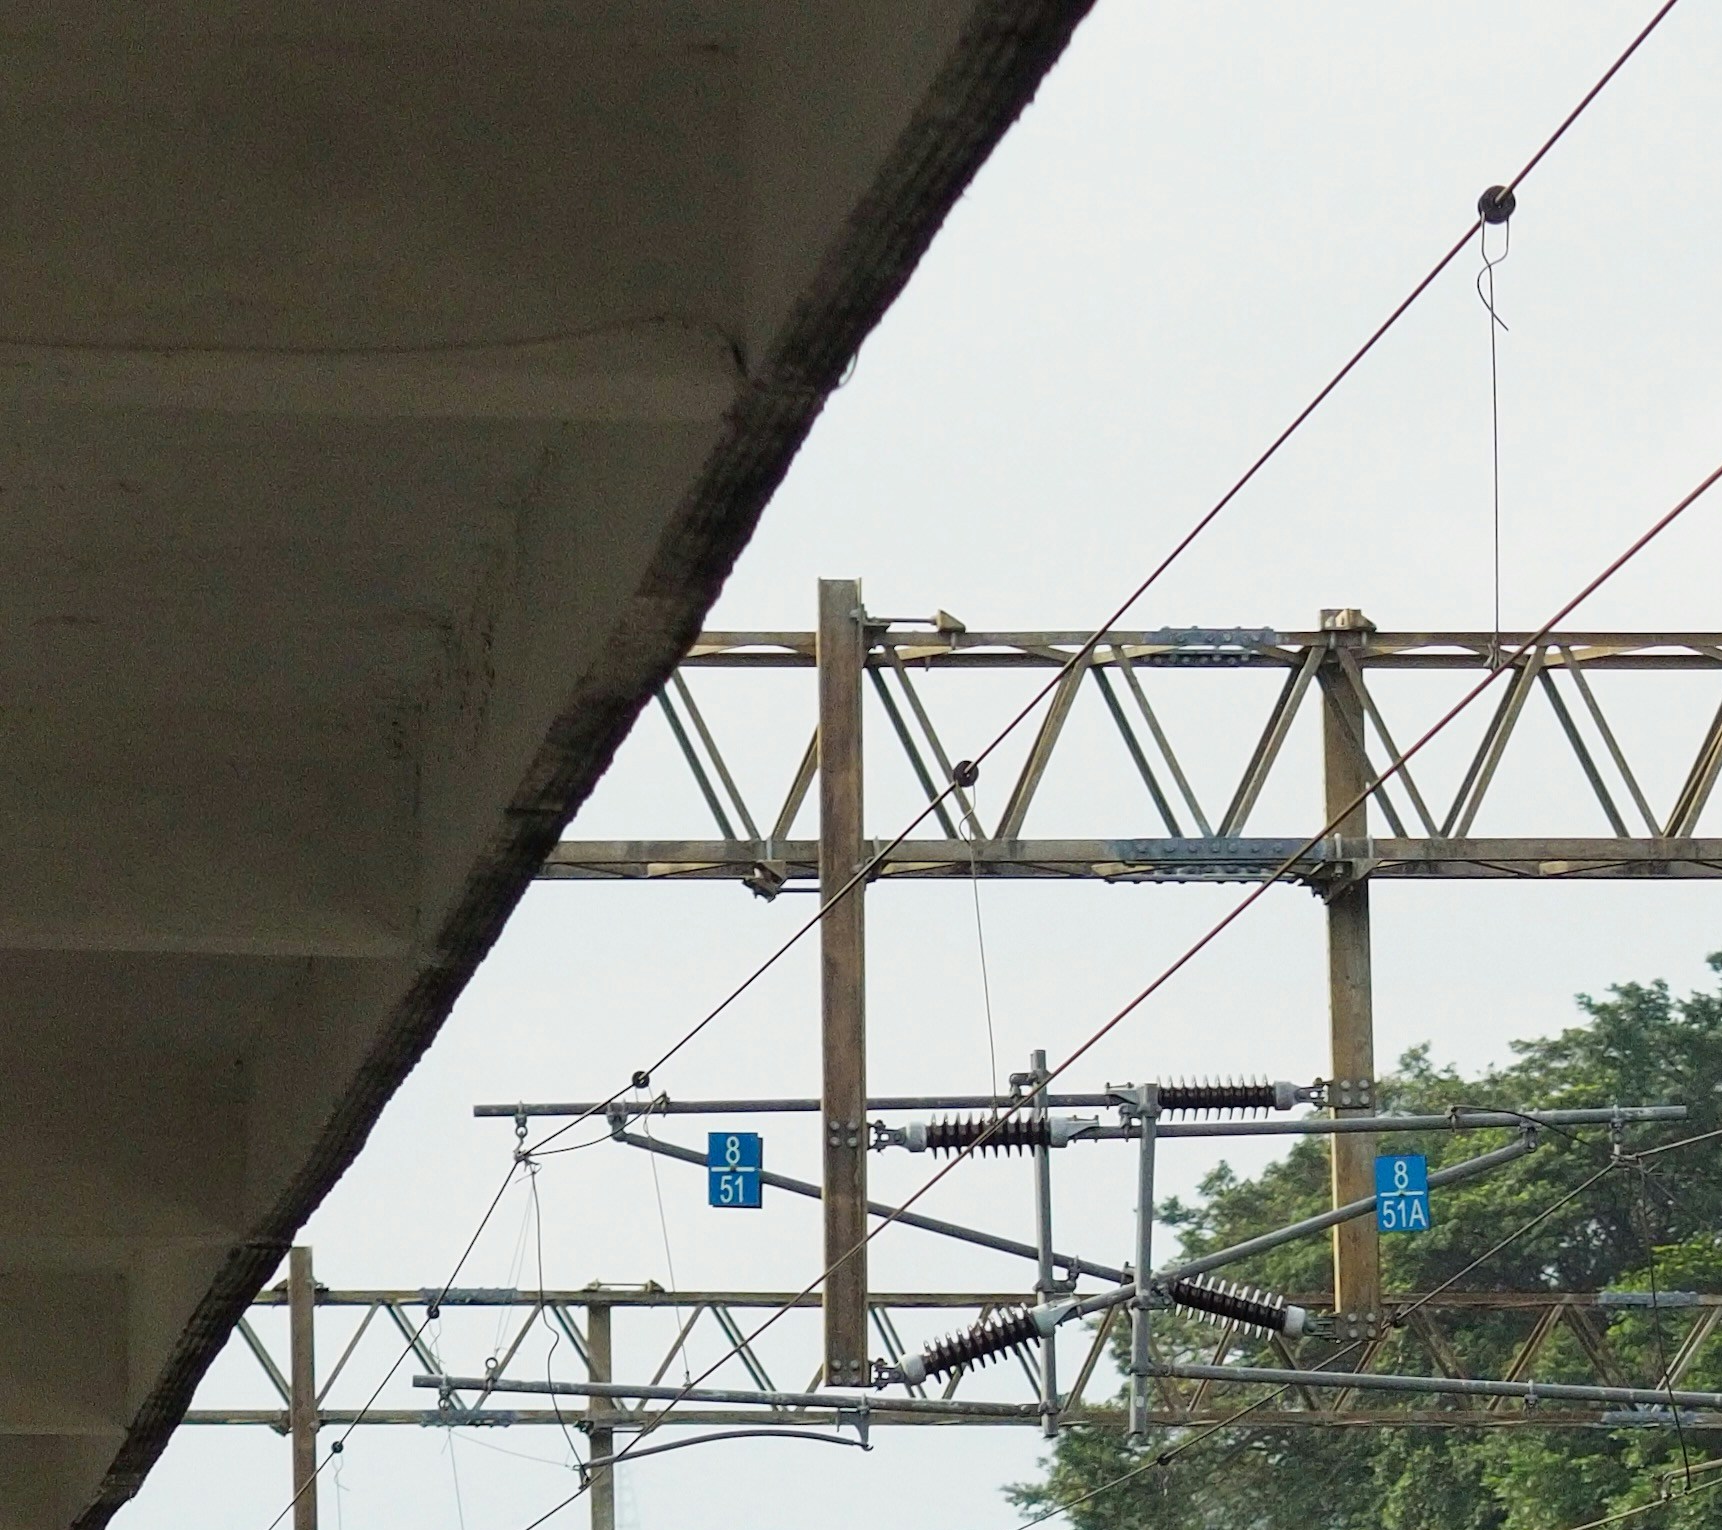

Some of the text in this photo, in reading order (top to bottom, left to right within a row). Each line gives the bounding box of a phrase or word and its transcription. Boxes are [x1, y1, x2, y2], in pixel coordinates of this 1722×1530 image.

[726, 1136, 740, 1164] 8
[720, 1175, 744, 1203] 51
[1394, 1161, 1408, 1189] 8
[1382, 1199, 1427, 1228] 51A
